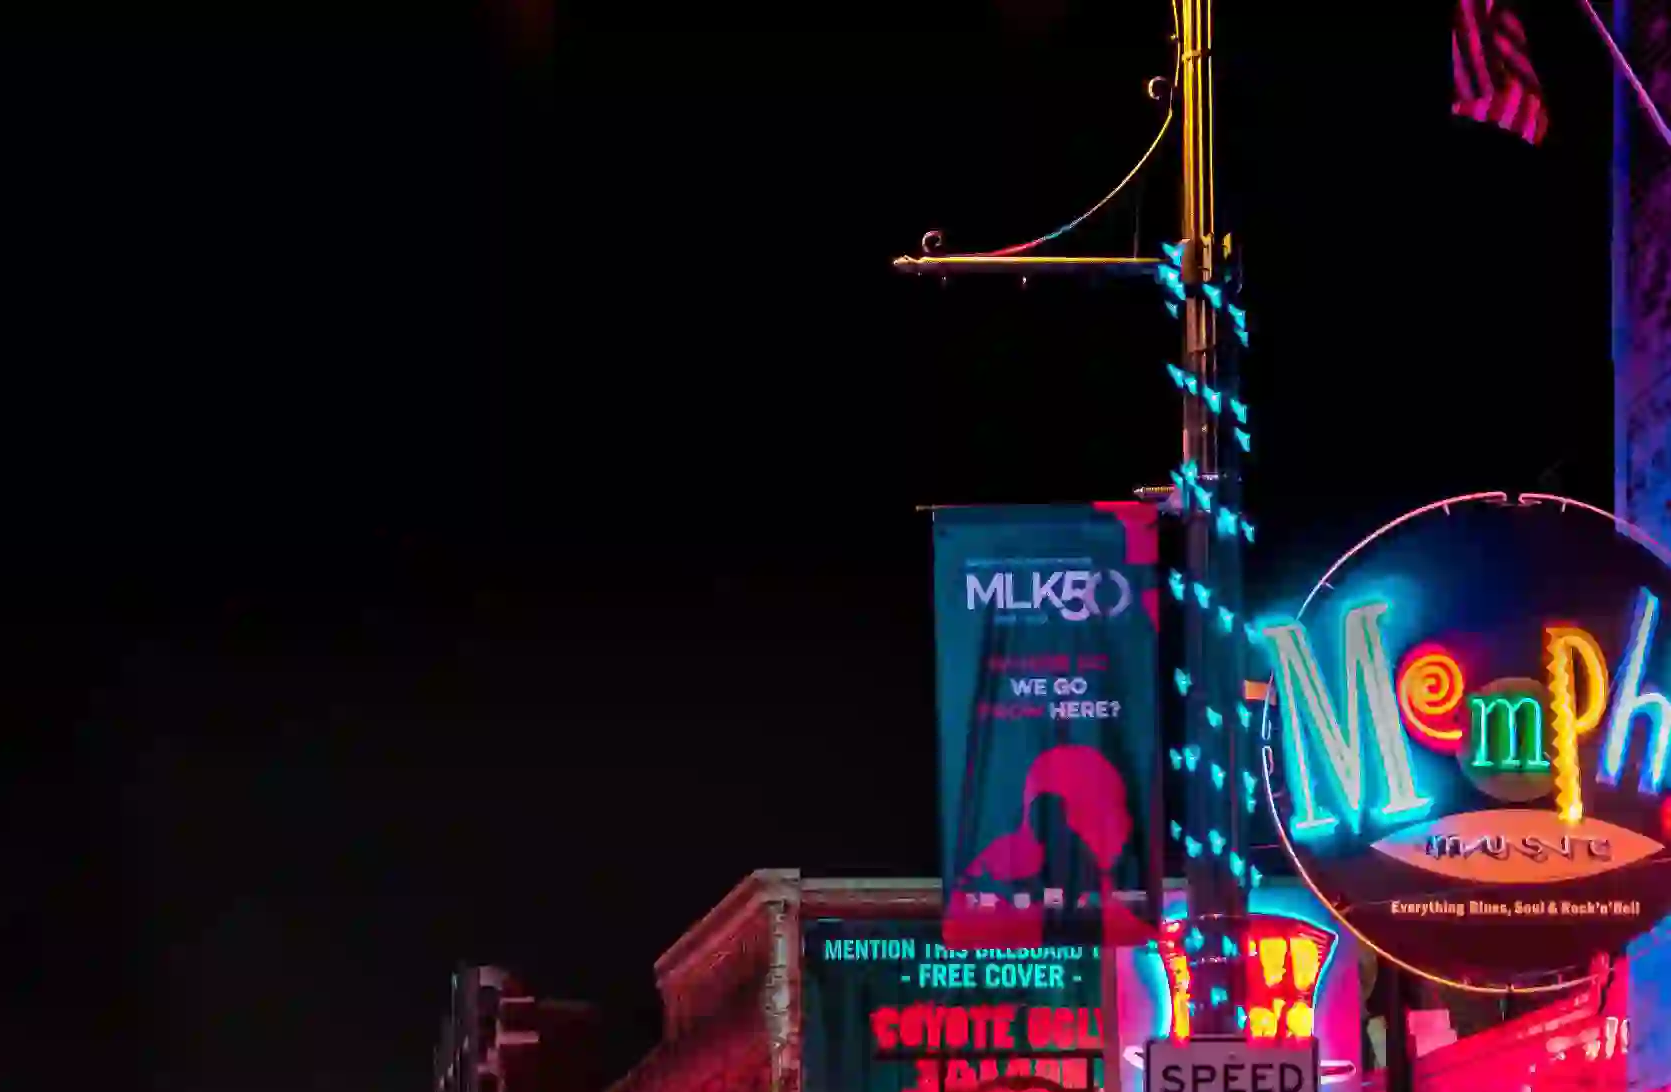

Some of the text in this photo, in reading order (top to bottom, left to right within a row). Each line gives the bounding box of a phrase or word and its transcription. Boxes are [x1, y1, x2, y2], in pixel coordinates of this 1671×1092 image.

[1010, 676, 1088, 697] WE GO
[1049, 700, 1122, 719] HERE?
[1391, 901, 1466, 917] Everything
[1514, 901, 1545, 914] Soul
[824, 939, 916, 960] MENTION
[918, 963, 1066, 989] FREE COVER
